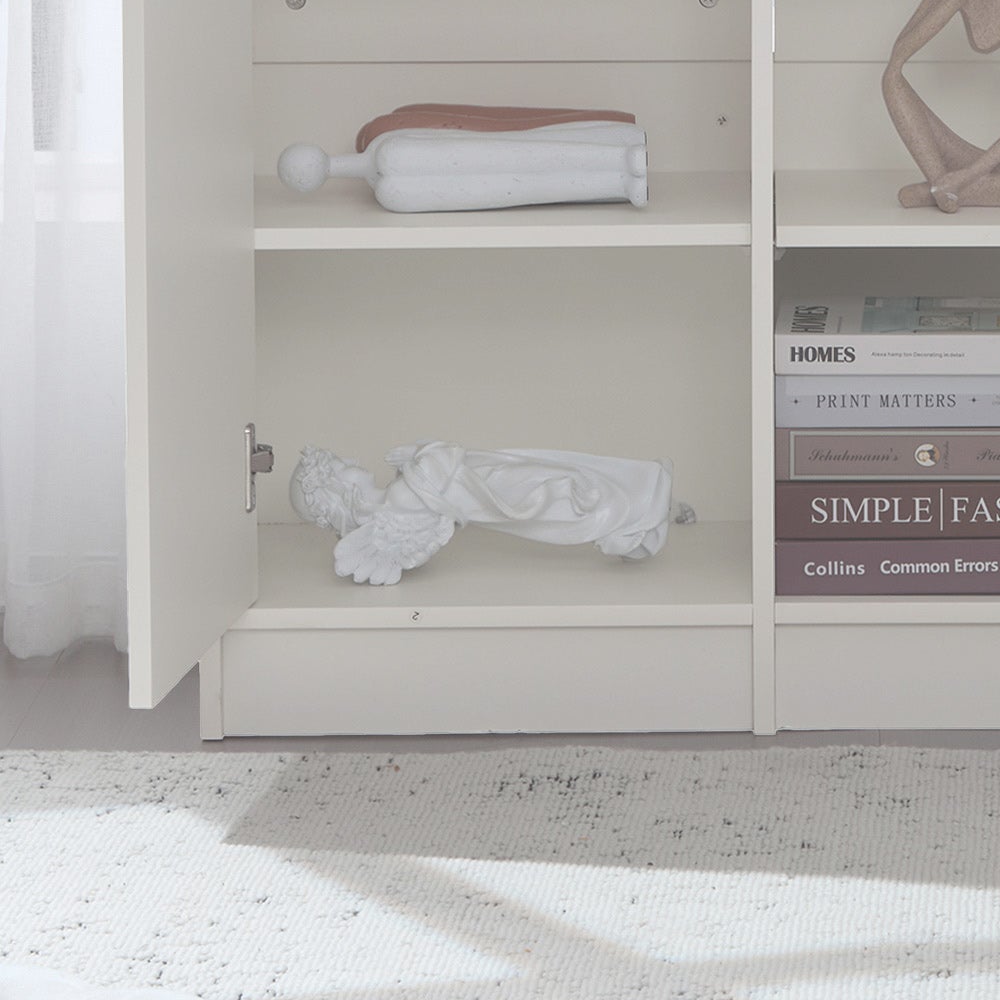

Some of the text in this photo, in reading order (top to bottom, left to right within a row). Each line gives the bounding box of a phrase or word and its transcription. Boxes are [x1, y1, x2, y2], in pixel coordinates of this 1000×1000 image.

[790, 346, 856, 363] HOMES
[816, 394, 957, 408] PRINT MATTERS
[811, 497, 933, 524] SIMPLE
[804, 561, 865, 576] Collins
[880, 560, 950, 574] Common
[954, 558, 999, 572] Errors
